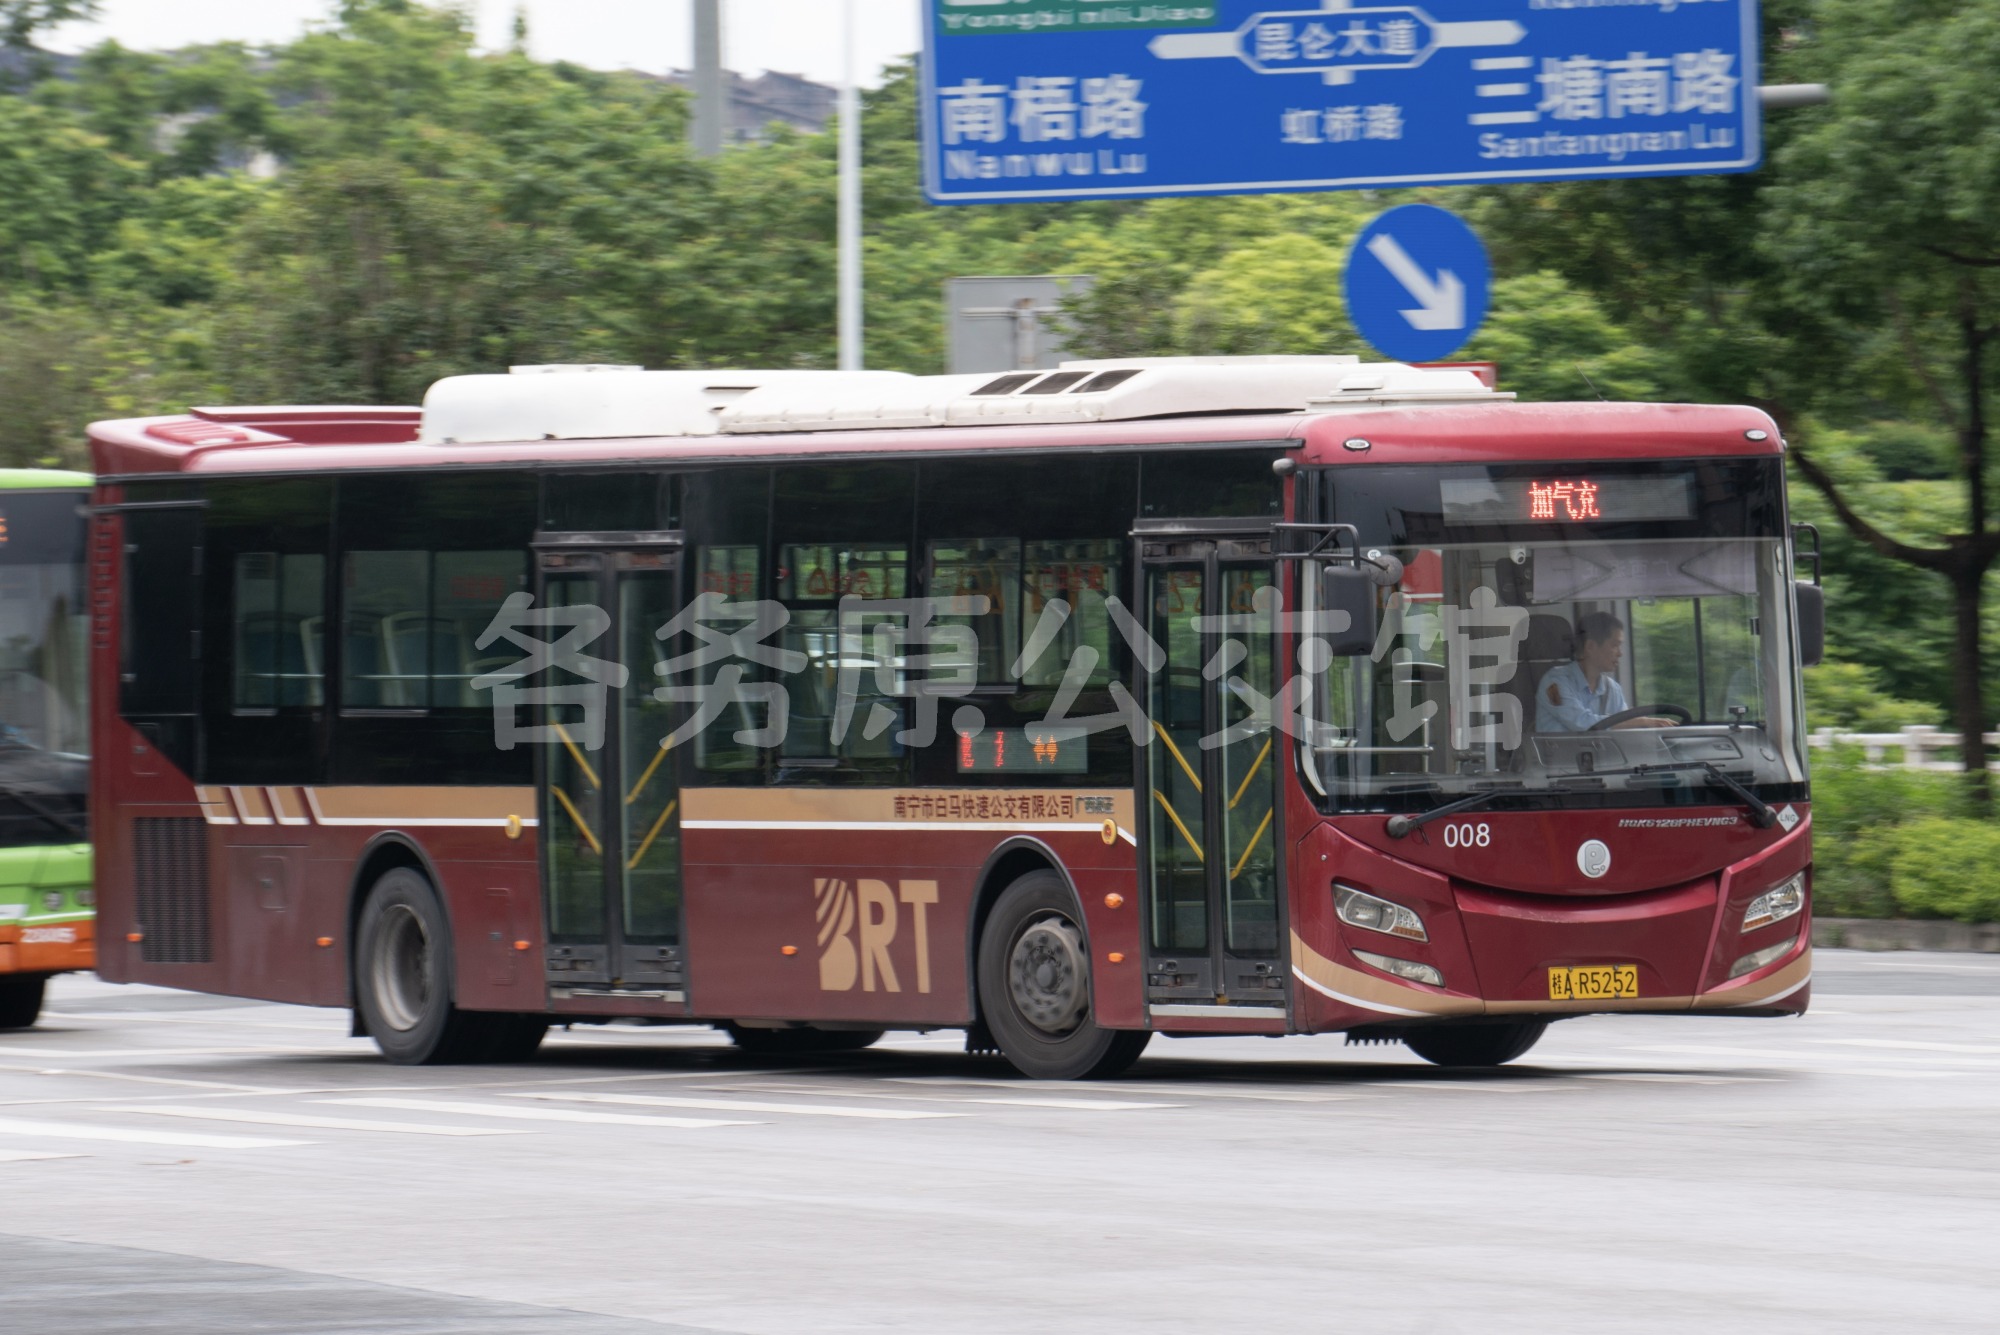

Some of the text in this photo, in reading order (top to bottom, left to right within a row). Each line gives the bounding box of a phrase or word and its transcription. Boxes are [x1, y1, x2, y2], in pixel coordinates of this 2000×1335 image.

[1254, 19, 1419, 61] 昆仑大道
[1467, 48, 1739, 126] 三塘南路
[937, 74, 1149, 145] 南梧路
[1478, 123, 1736, 161] Santangnan Lu
[1098, 149, 1148, 175] Lu
[893, 794, 1074, 819] 南宁市白马快速公交有限公司
[1780, 814, 1797, 823] LNG
[1444, 823, 1490, 848] 008
[814, 878, 939, 993] BRT
